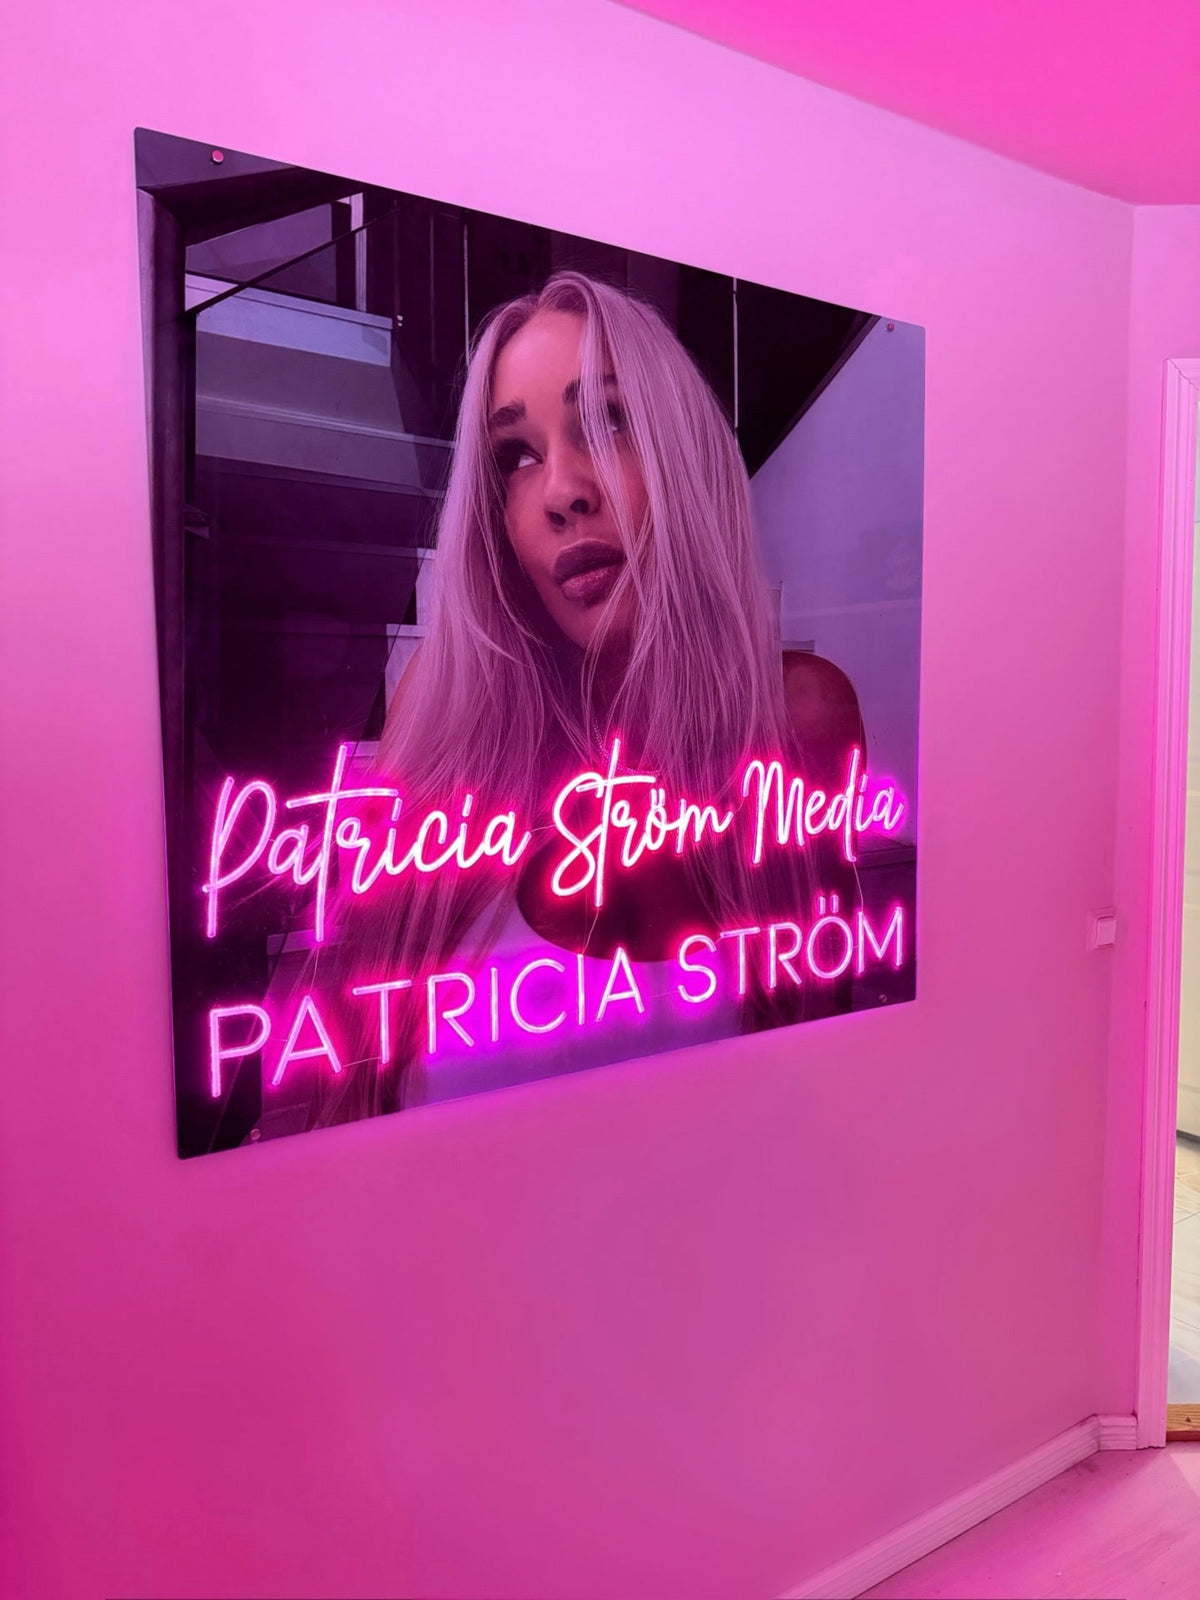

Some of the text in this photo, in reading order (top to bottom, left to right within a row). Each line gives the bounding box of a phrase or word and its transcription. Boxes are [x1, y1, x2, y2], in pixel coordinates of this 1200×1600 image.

[202, 738, 905, 943] Patricia Ström Media
[209, 894, 904, 1099] PATRICIA STRÖM
